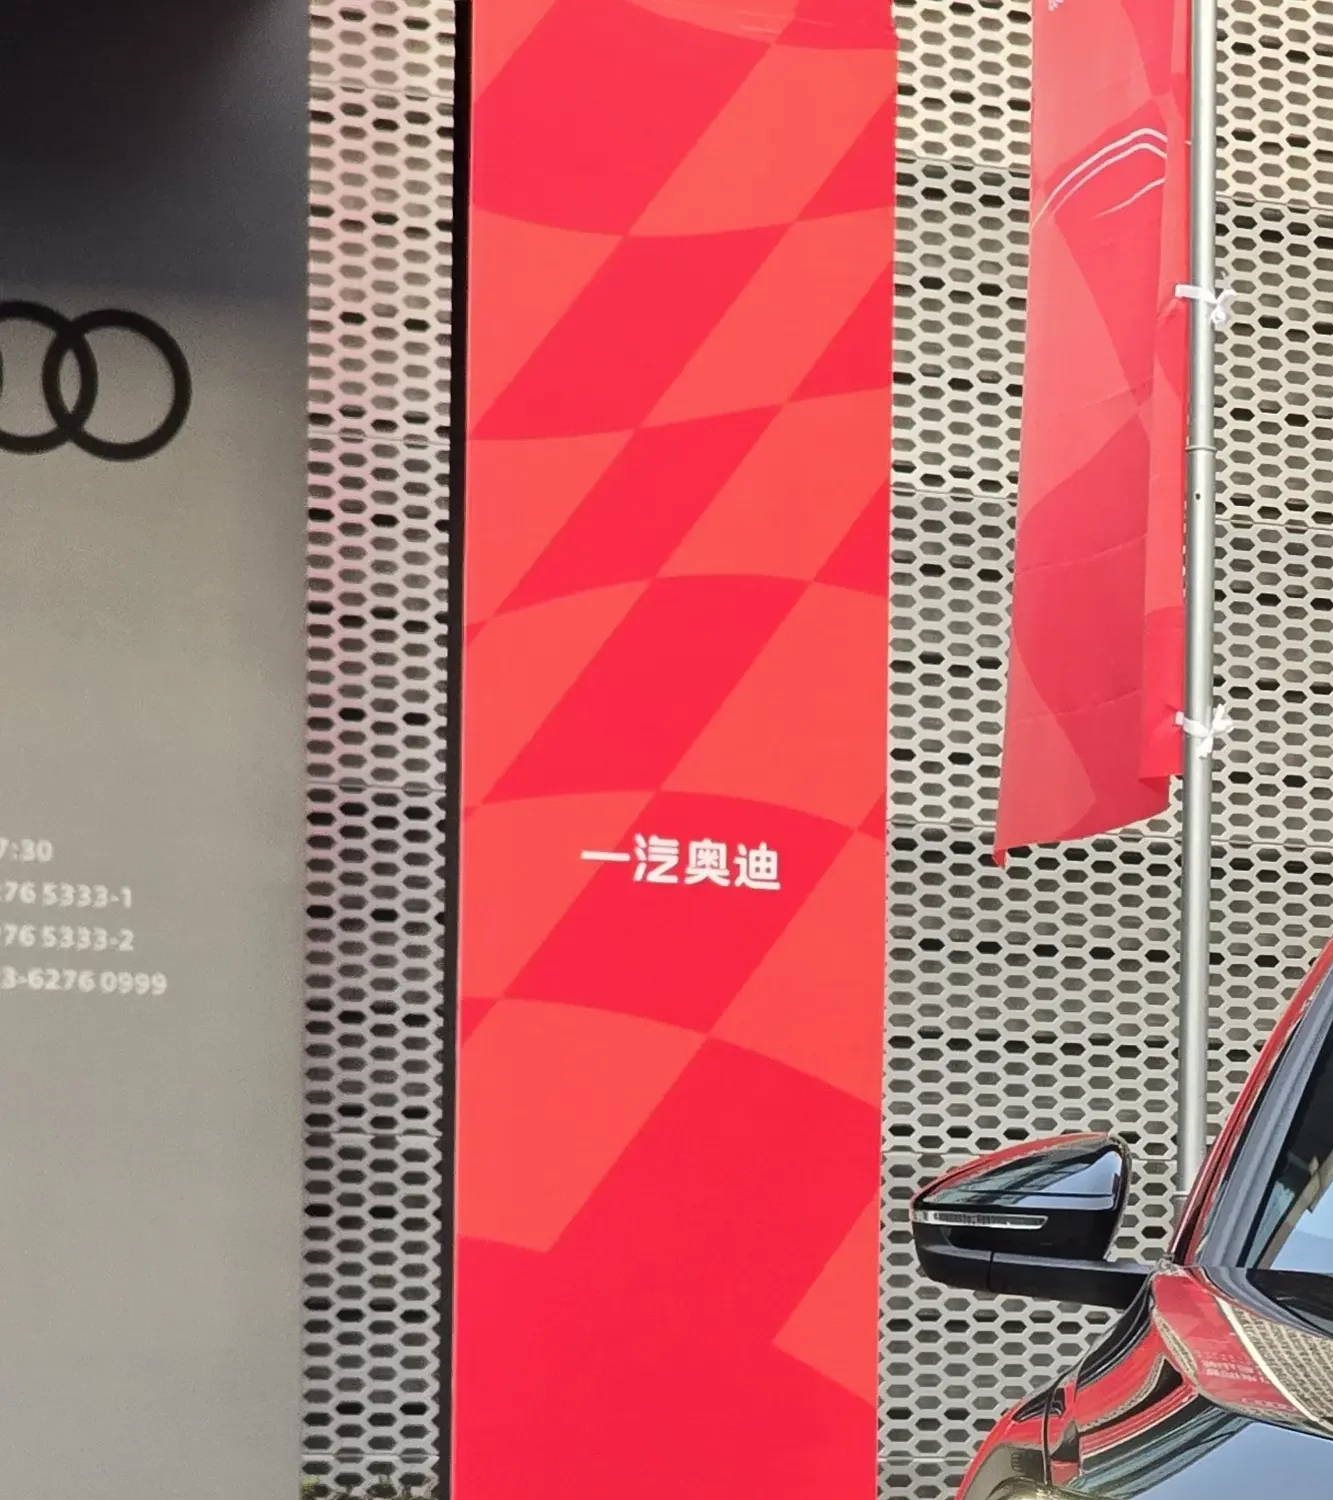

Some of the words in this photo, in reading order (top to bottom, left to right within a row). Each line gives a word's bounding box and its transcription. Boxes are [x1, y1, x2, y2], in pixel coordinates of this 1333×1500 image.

[579, 833, 782, 891] 一汽奥迪
[0, 880, 37, 905] 76
[41, 881, 133, 909] 5333-1
[0, 923, 37, 948] 76
[40, 924, 135, 952] 5333-2
